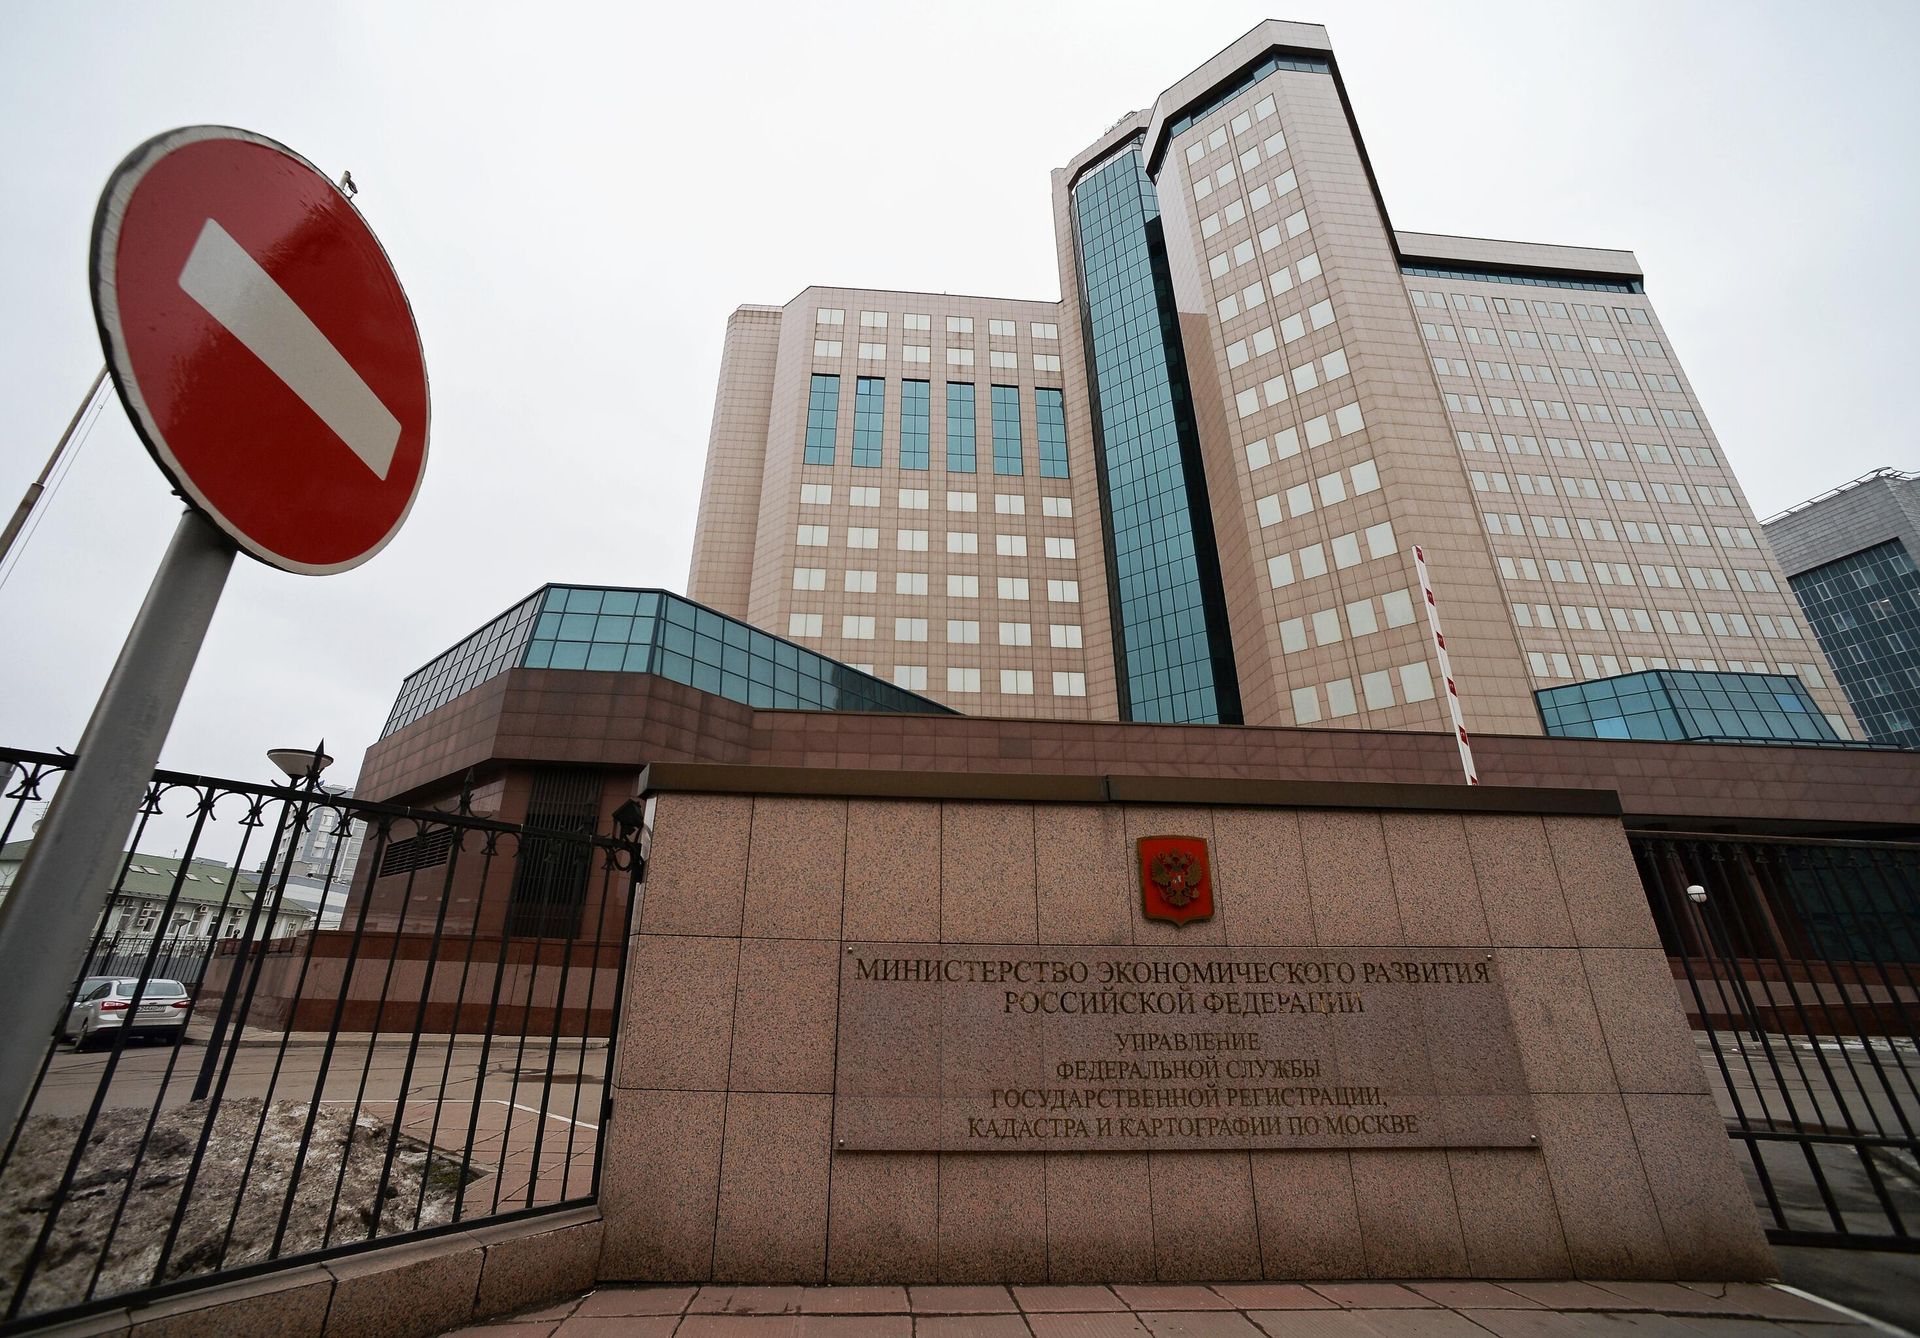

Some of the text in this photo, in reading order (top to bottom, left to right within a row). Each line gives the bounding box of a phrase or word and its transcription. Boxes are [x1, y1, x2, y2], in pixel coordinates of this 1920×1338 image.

[855, 958, 1491, 984] МИНИСТЕРСТВО ЭКОНОМИЧЕСКОГО РАЗВИТИЯ
[1004, 986, 1365, 1018] РОССИЙСКОЙ ФЕДЕРАЦИИ
[1115, 1032, 1261, 1051] УПРАВЛЕНИЕ
[1056, 1055, 1321, 1082] ФЕДЕРАЛЬНОЙ СЛУЖБЫ
[991, 1083, 1388, 1111] ГОСУДАРСТВЕННОЙ РЕГИСТРАЦИИ,
[968, 1114, 1419, 1142] КАДАСТРА И КАРТОГРАФИИ ПО МОСКВЕ
